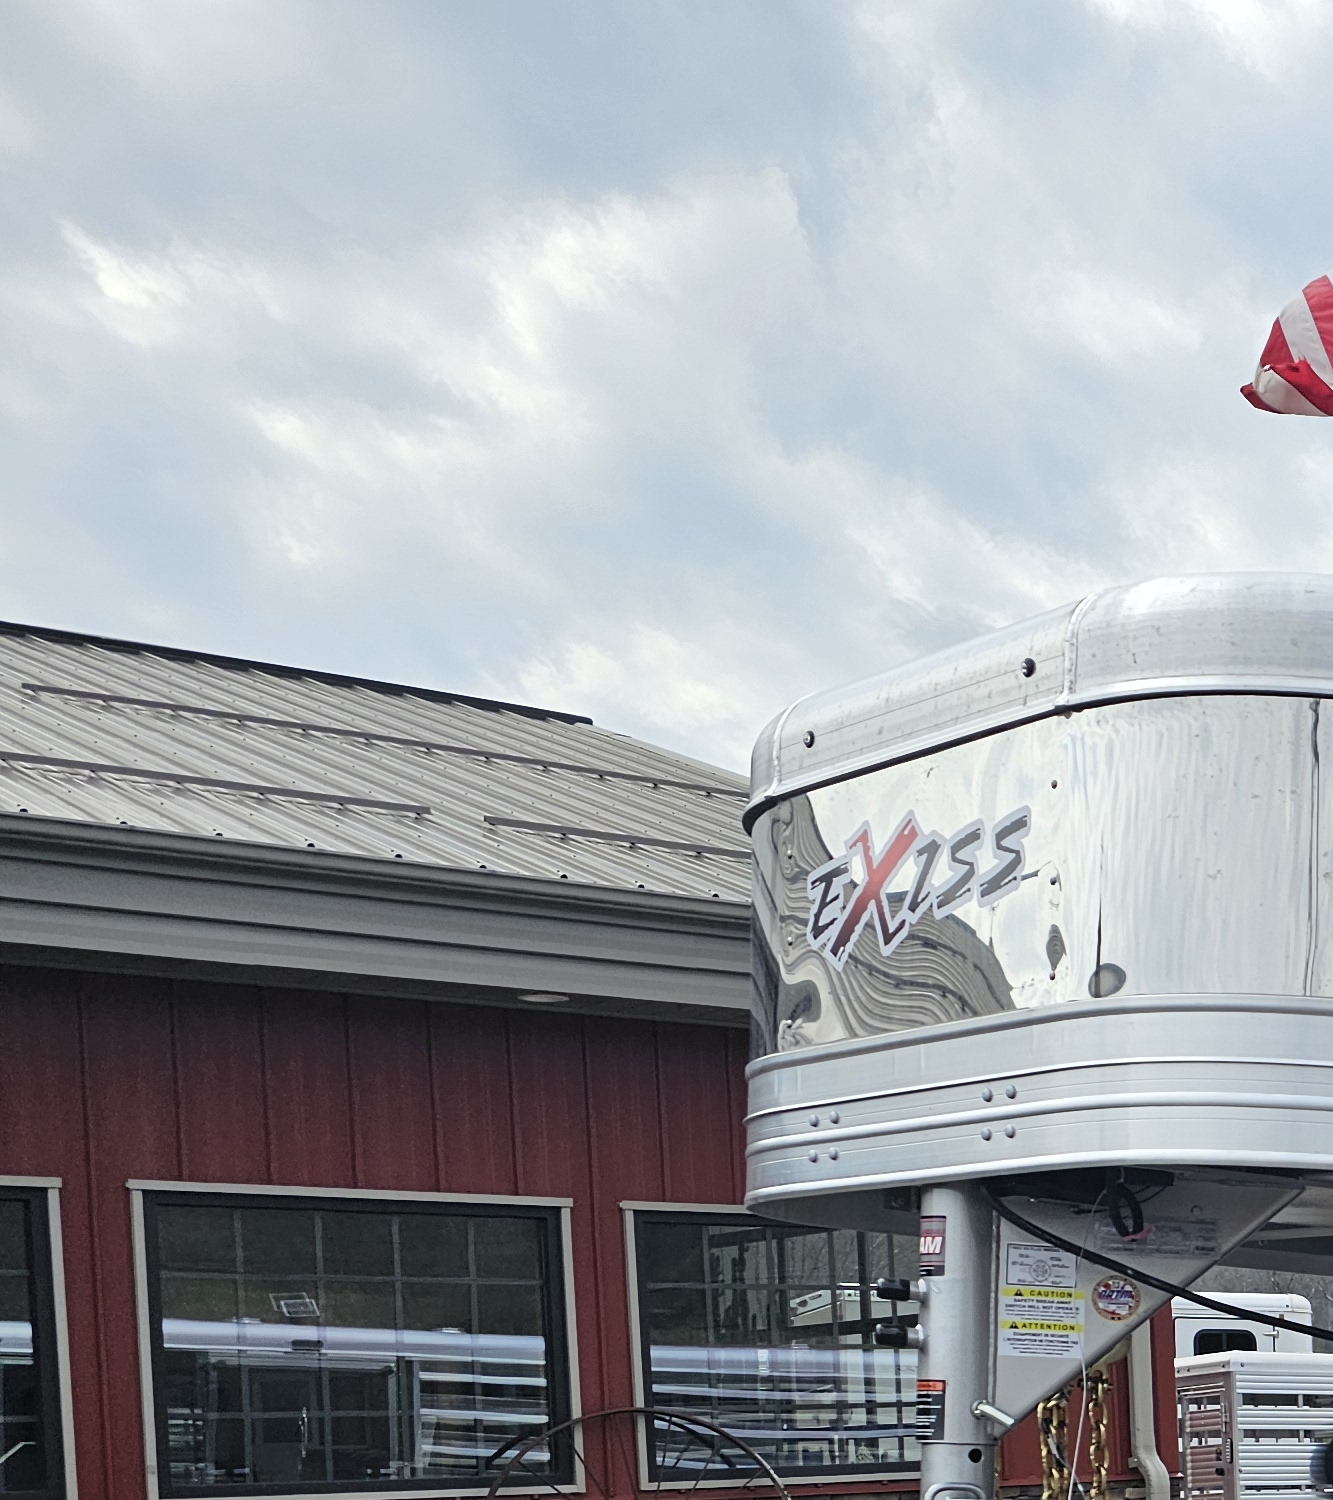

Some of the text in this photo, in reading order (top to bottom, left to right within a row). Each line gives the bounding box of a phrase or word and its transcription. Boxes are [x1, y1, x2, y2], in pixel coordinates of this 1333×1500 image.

[810, 814, 1029, 958] EXISS
[1029, 1289, 1073, 1299] CAUTION
[1021, 1322, 1075, 1331] ATTENTION
